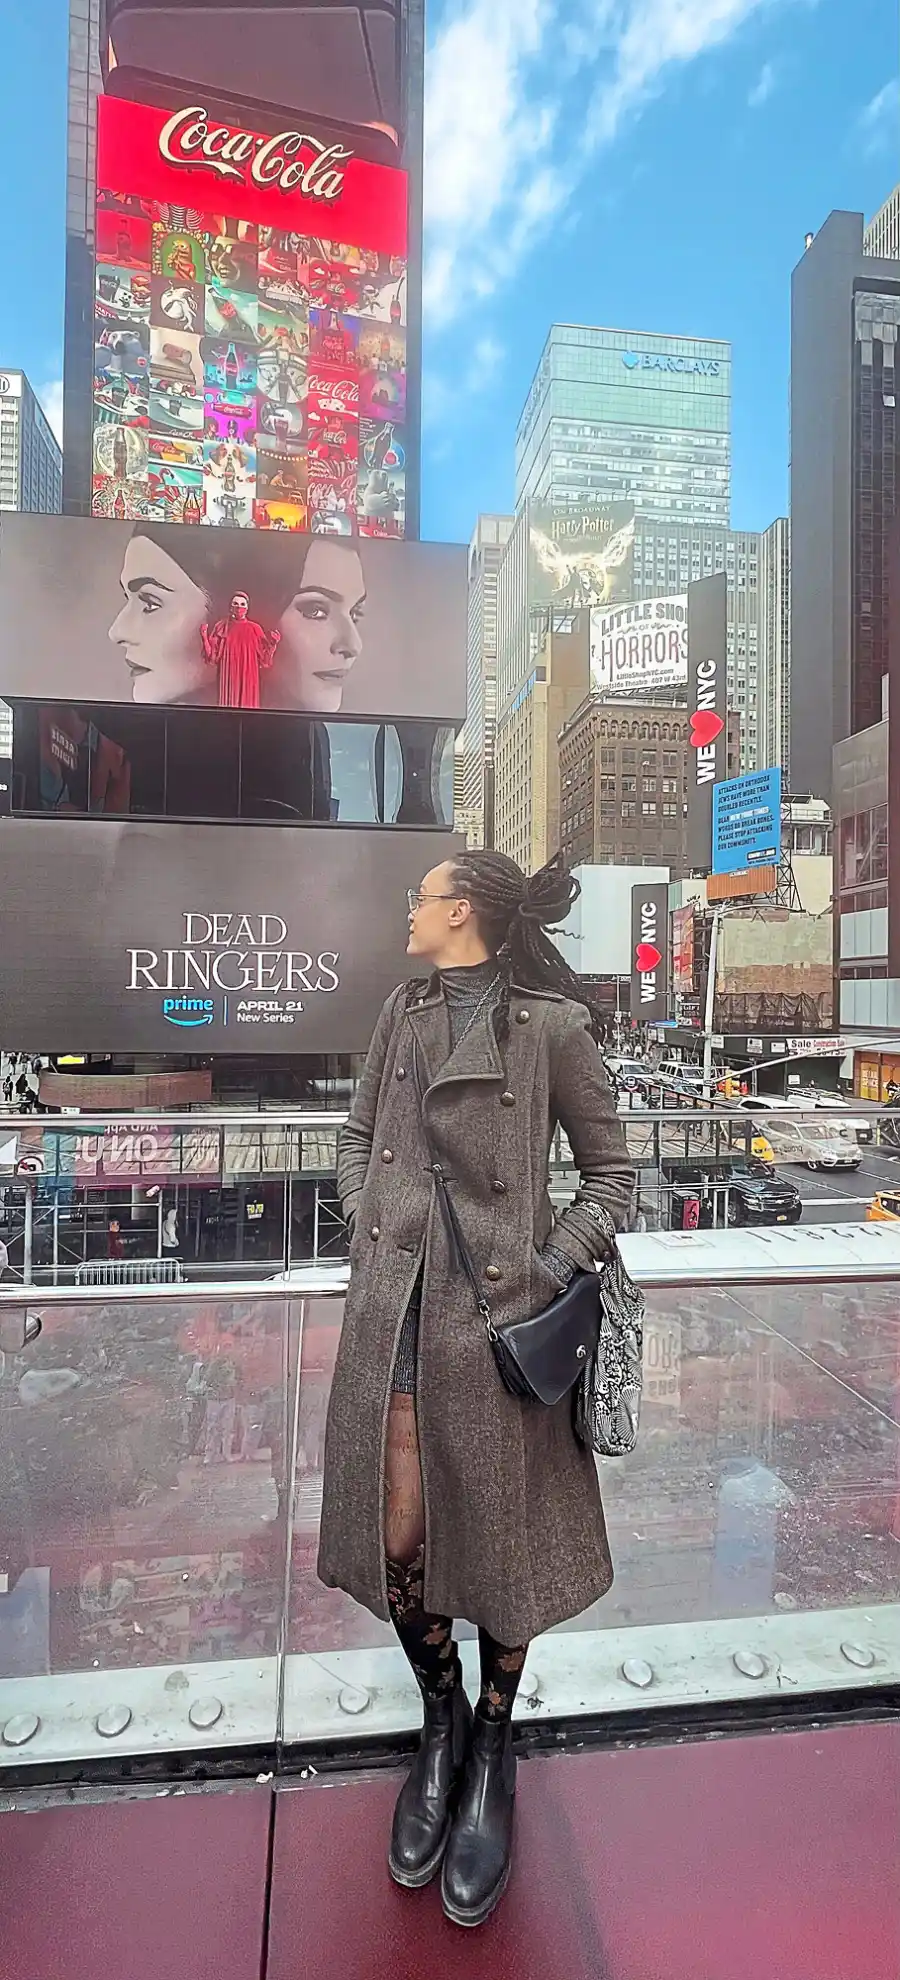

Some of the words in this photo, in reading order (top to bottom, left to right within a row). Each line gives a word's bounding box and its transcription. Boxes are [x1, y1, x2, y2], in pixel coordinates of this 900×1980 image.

[641, 355, 720, 376] BARCLAYS
[551, 519, 580, 540] Harry
[581, 516, 614, 536] Potter
[601, 603, 652, 636] LITTLE
[696, 659, 717, 710] NYC
[696, 743, 717, 785] WE
[182, 912, 288, 947] DEAD
[641, 902, 657, 942] NYC
[124, 948, 341, 994] RINGERS
[641, 971, 656, 1004] WE
[163, 994, 214, 1014] prime
[236, 1001, 284, 1012] APRIL
[285, 1001, 304, 1012] 21
[236, 1012, 261, 1023] New
[262, 1012, 295, 1023] Series
[791, 1039, 812, 1048] Sale
